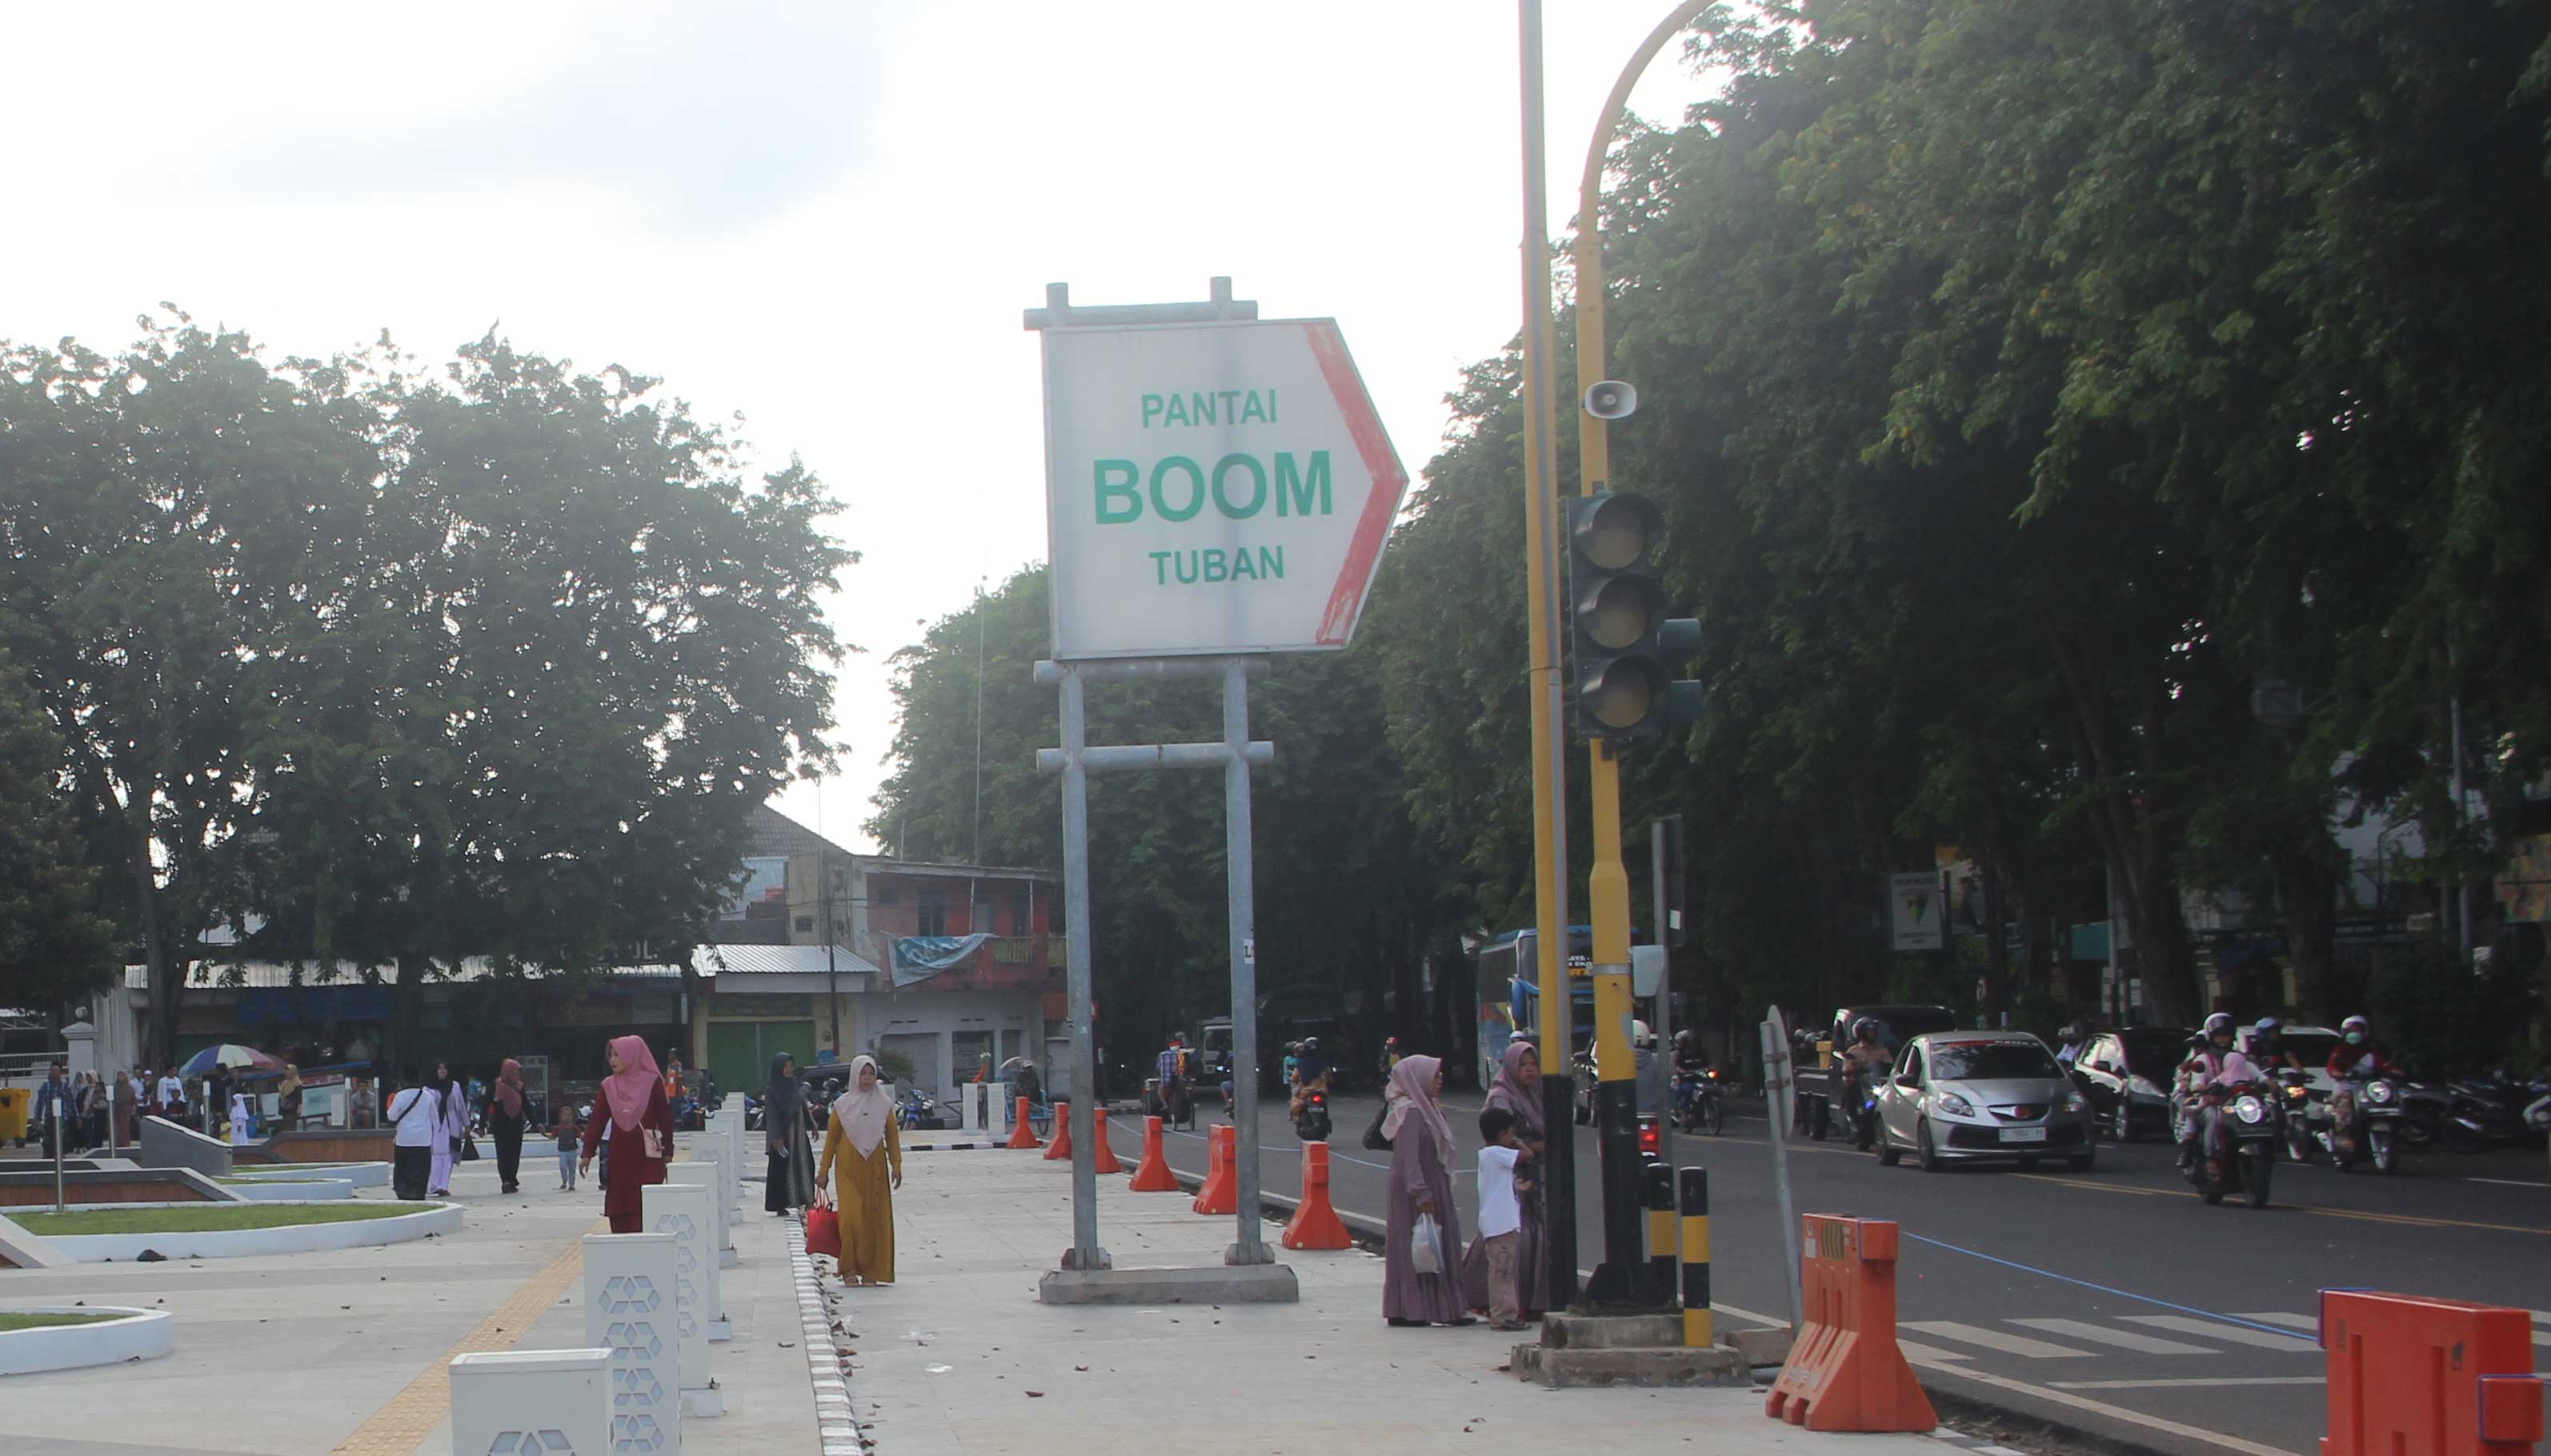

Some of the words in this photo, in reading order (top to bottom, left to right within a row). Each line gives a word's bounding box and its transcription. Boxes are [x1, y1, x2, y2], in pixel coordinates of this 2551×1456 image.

[1142, 388, 1278, 428] PANTAI
[1093, 449, 1334, 525] BOOM
[1148, 544, 1285, 586] TUBAN
